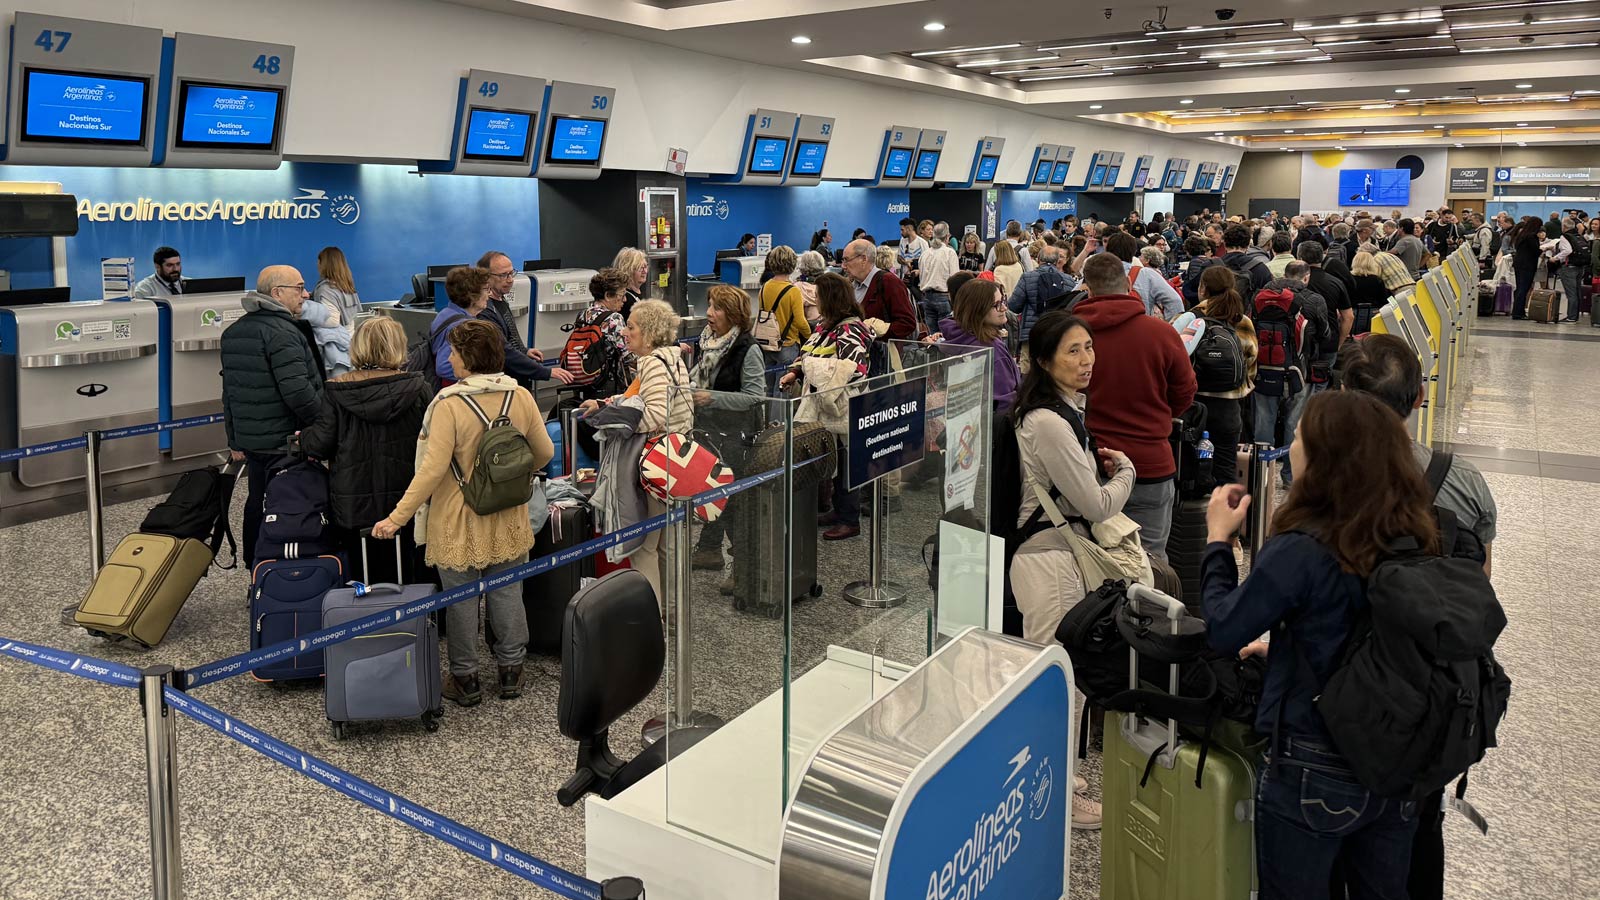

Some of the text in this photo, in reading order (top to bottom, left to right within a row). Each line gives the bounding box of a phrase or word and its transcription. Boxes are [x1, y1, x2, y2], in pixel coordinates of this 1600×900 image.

[34, 30, 72, 52] 47
[252, 55, 280, 75] 48
[63, 92, 102, 100] Argentinas
[478, 82, 498, 97] 49
[592, 96, 608, 110] 50
[59, 121, 98, 130] Nacionales
[69, 114, 101, 122] Destinos
[760, 117, 772, 128] 51
[820, 124, 831, 135] 52
[858, 401, 917, 430] DESTINOS SUR
[866, 424, 910, 448] (Southern national
[872, 442, 903, 460] destinations)
[202, 662, 242, 678] despegar
[264, 651, 280, 659] HELLO
[312, 629, 346, 644] despegar
[406, 600, 436, 614] despegar
[488, 573, 515, 586] despegar
[560, 548, 583, 560] despegar
[623, 527, 643, 538] despegar
[11, 646, 38, 656] despegar
[82, 663, 110, 675] despegar
[164, 691, 188, 707] despegar
[234, 727, 260, 744] despegar
[311, 765, 341, 784] despegar
[346, 782, 358, 792] HOLA
[401, 806, 435, 828] despegar
[452, 832, 466, 842] SALUT
[469, 839, 485, 850] HALLO
[504, 853, 544, 876] despegar
[564, 881, 581, 892] SALUT
[926, 778, 1025, 900] Aerolíneas
[953, 817, 1022, 900] entinas
